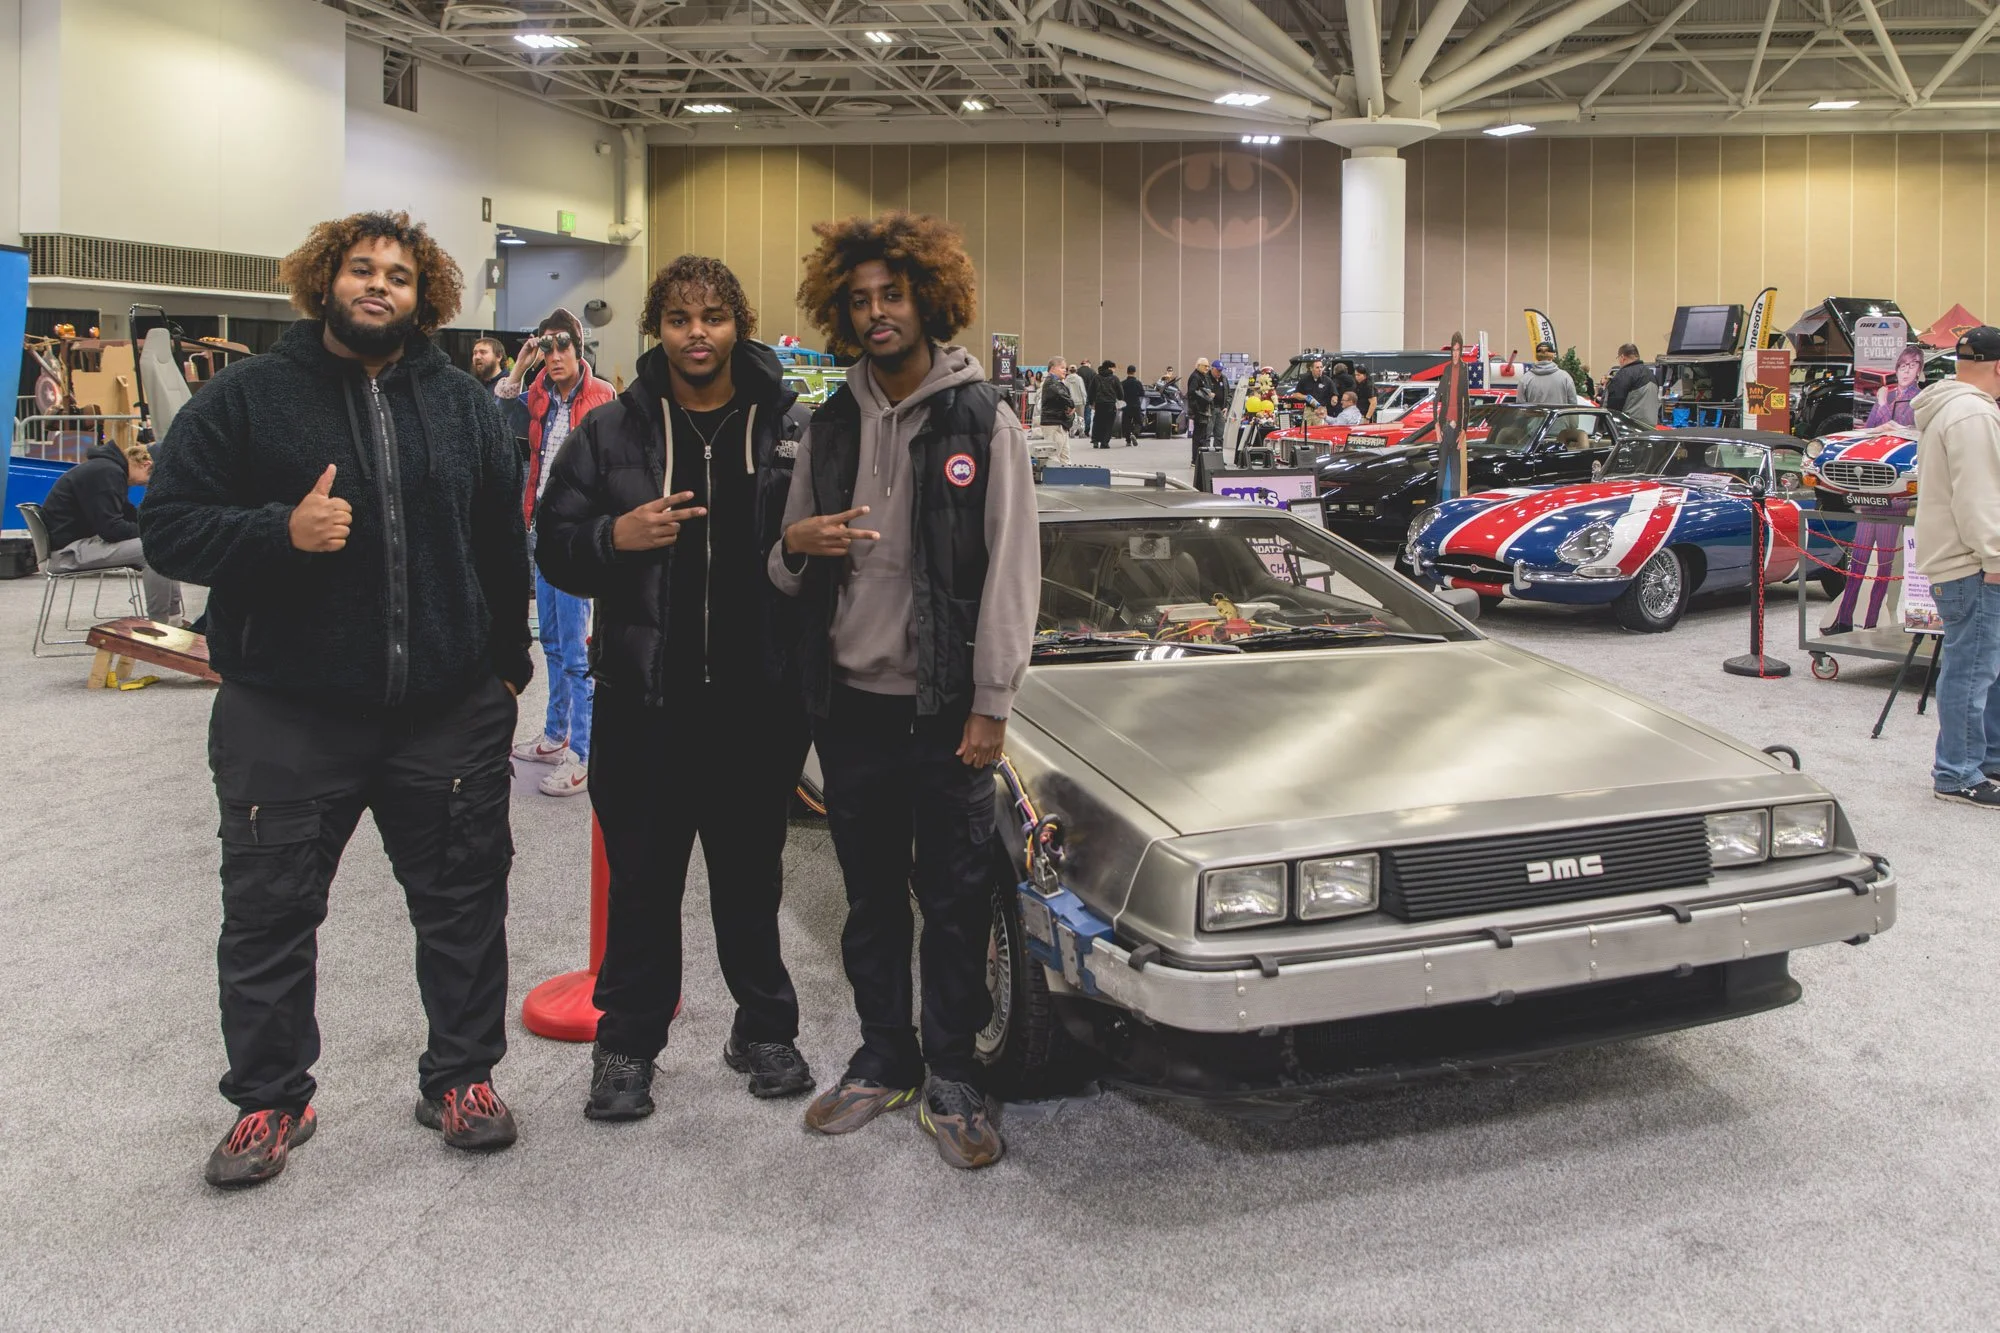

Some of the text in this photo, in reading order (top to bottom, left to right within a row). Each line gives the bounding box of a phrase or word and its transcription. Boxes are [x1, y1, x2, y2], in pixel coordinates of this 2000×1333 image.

[1863, 347, 1897, 358] EVOLVE
[1749, 387, 1764, 395] MN
[1846, 495, 1889, 506] SWINGER
[1527, 854, 1604, 884] DMC
